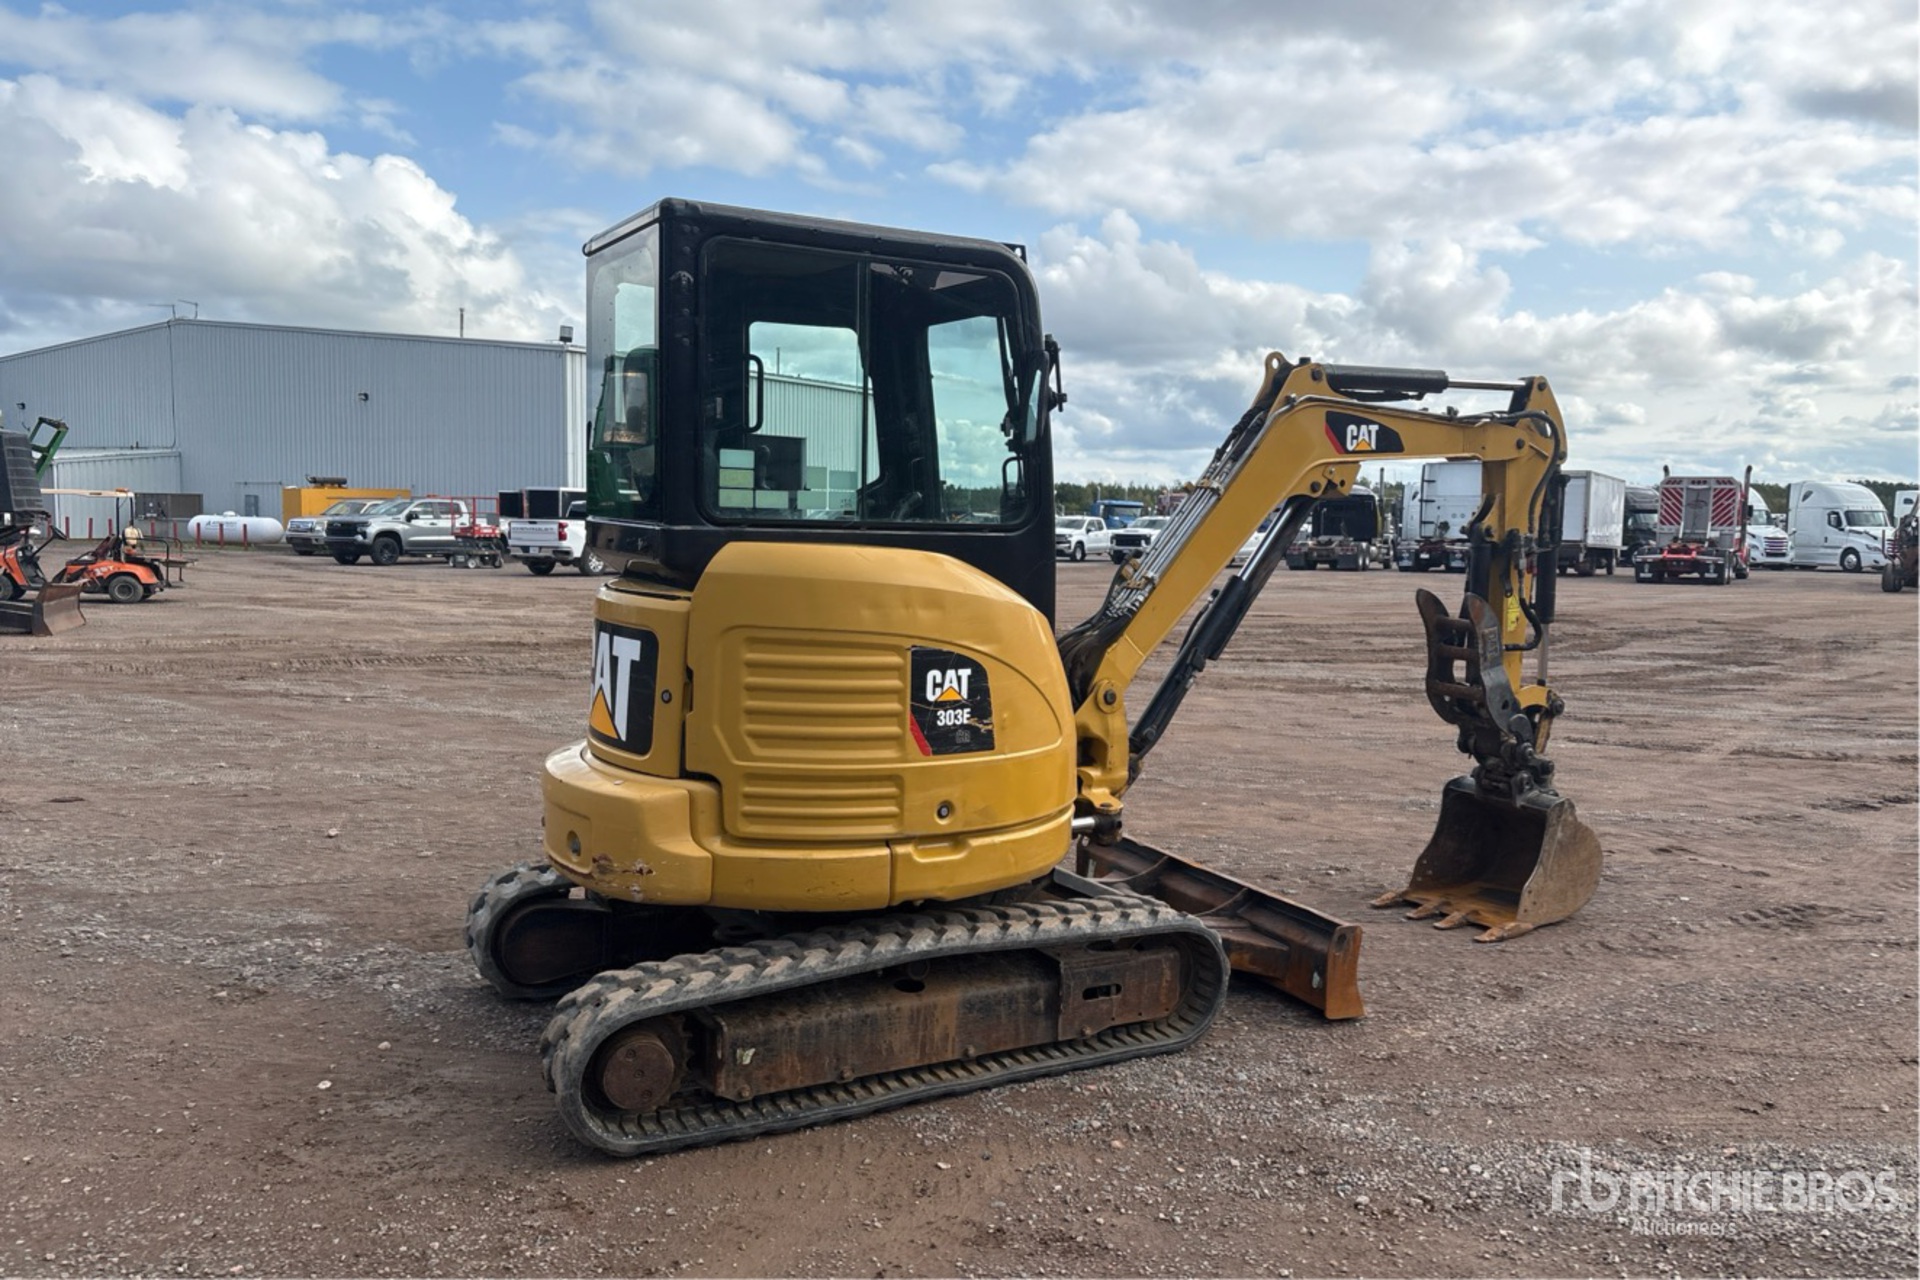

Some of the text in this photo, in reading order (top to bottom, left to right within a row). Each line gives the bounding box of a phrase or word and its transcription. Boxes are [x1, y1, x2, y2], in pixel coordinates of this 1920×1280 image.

[1346, 424, 1379, 451] CAT
[591, 631, 641, 741] AT
[926, 668, 971, 702] CAT
